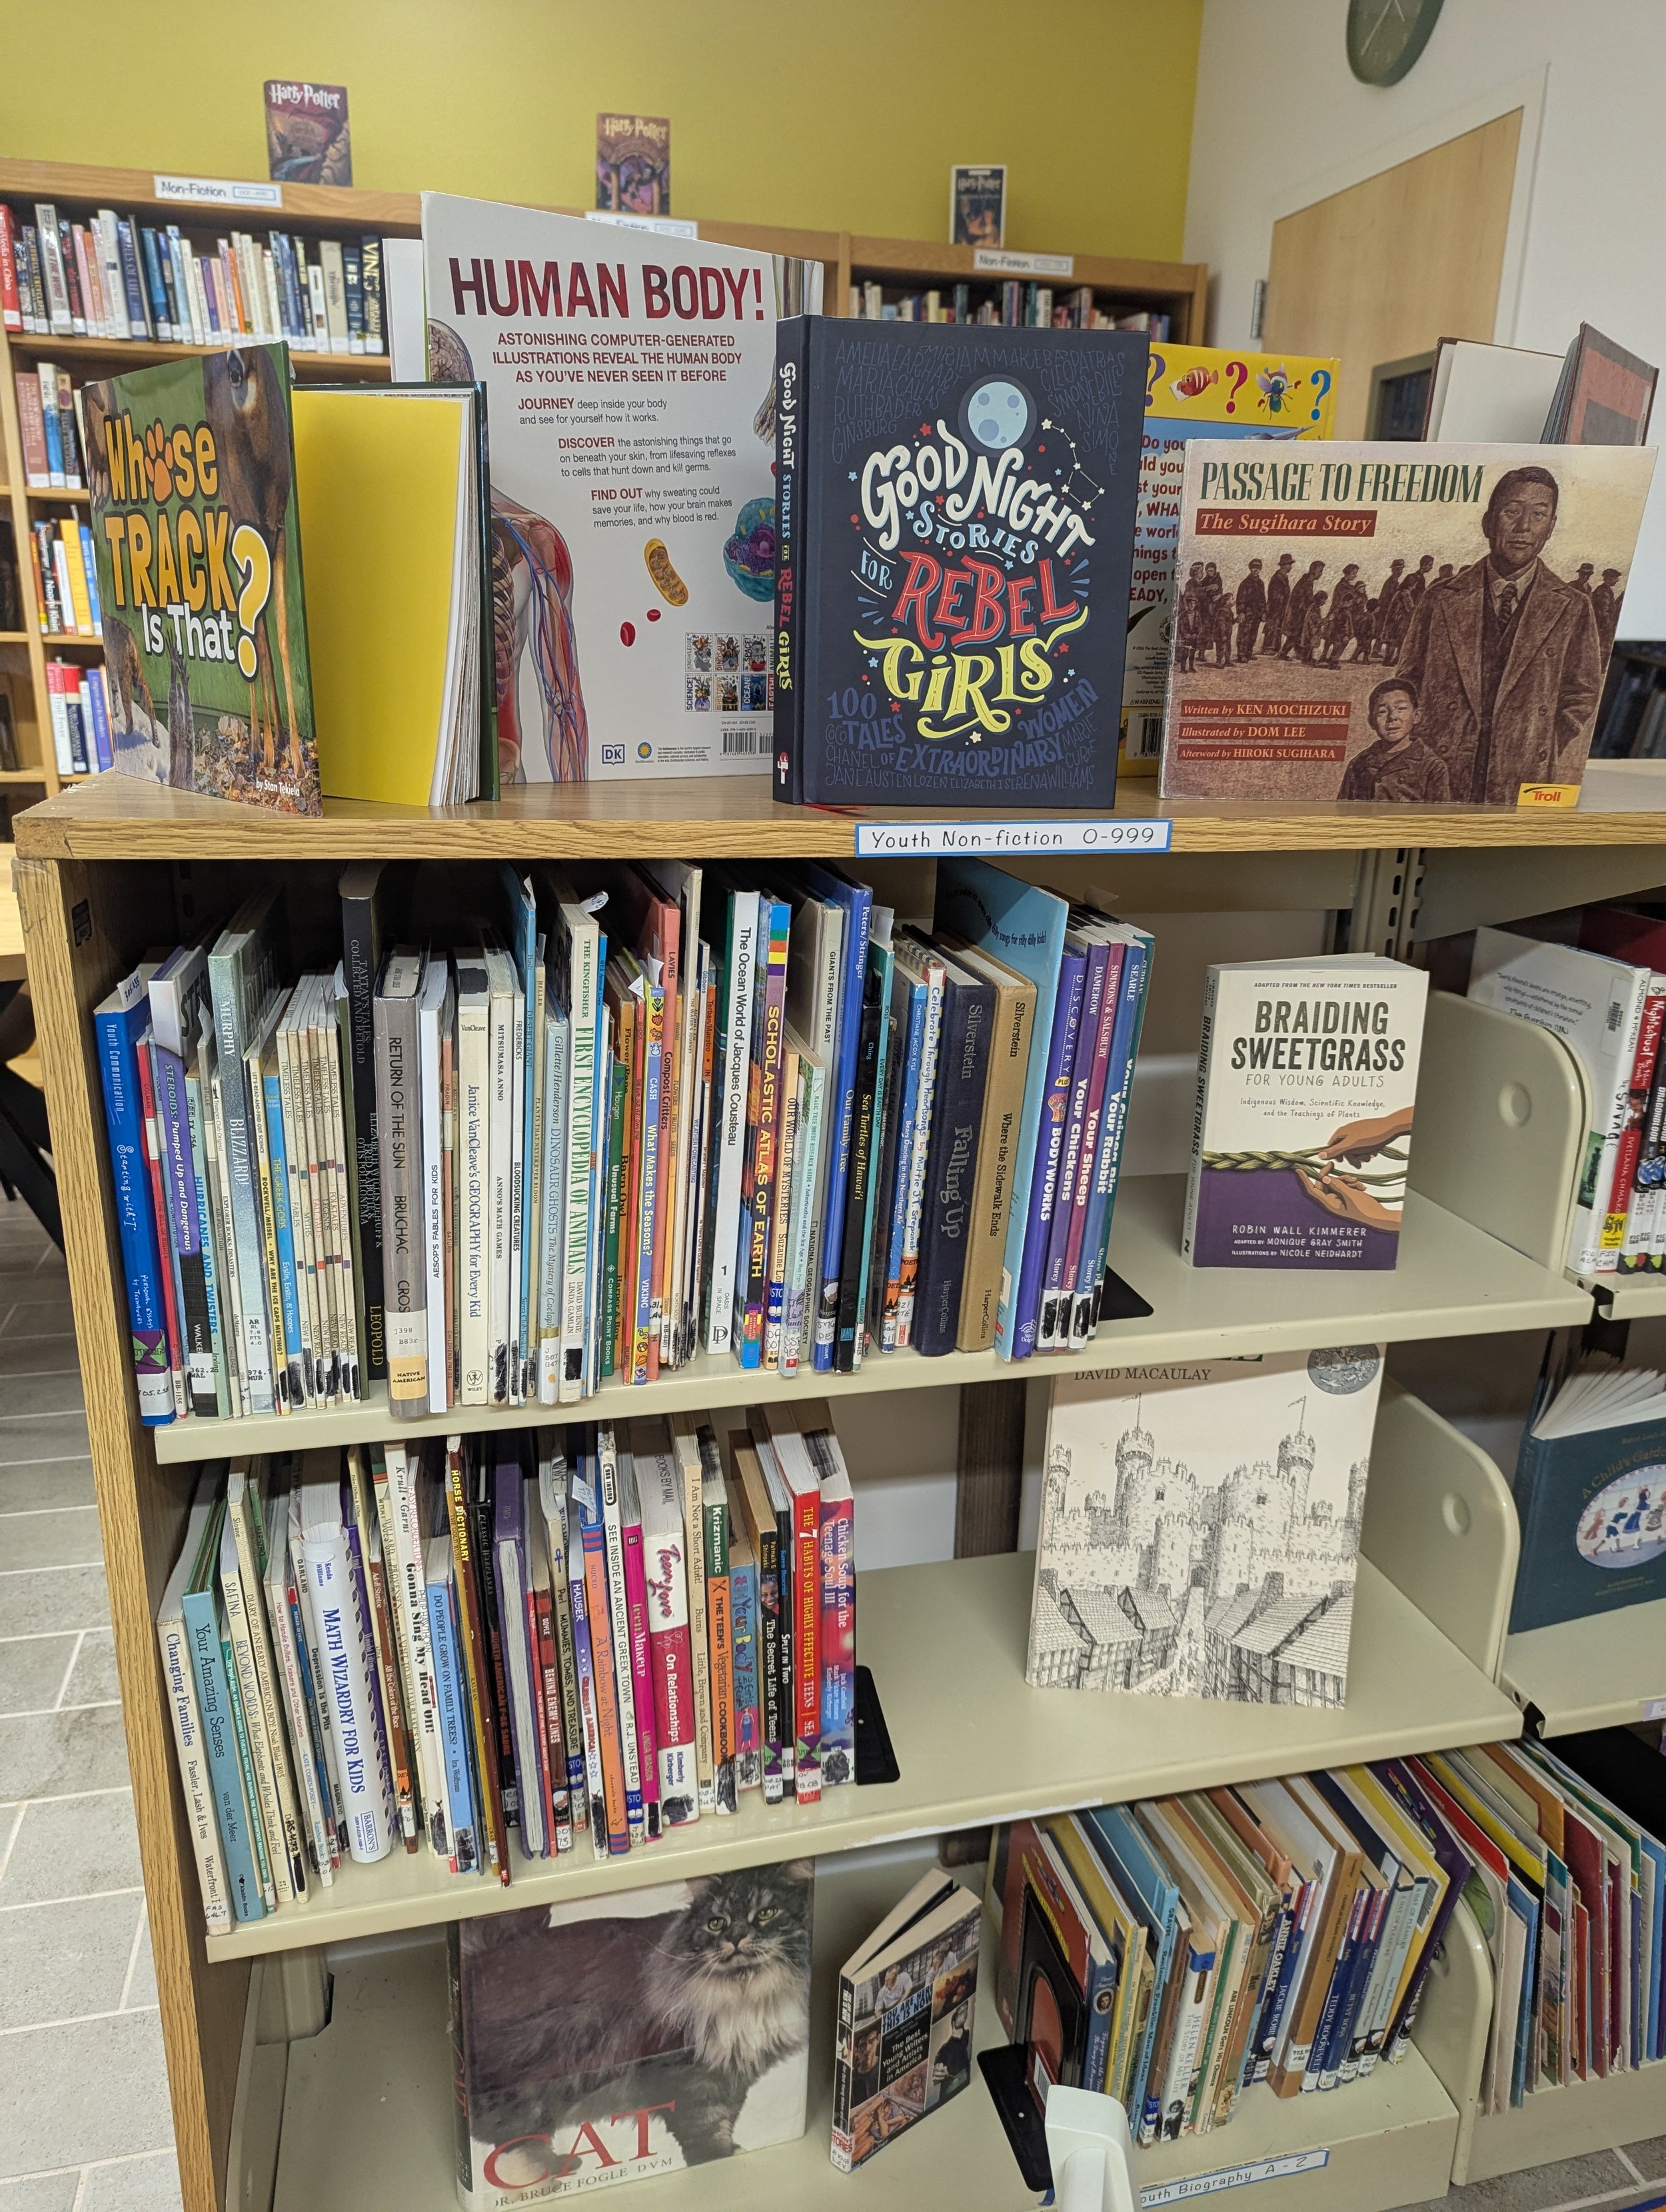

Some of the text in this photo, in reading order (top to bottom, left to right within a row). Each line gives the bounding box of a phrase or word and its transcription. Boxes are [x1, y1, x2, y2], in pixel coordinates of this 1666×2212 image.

[161, 181, 226, 198] Non-Fiction
[449, 257, 764, 320] HUMAN BODY!
[493, 352, 742, 364] ILLUSTRATIONS REVEAL THE HUMAN BODY
[498, 333, 734, 347] ASTONISHING COMPUTER-GENERATED
[516, 370, 726, 382] AS YOU'VE NEVER SEEN IT BEFORE
[518, 398, 667, 412] JOURNEY deep inside your body
[558, 436, 732, 449] DISCOVER the astonishing things that go
[1200, 462, 1486, 504] PASSAGE TO FREEDOM
[913, 500, 1040, 564] STORIES
[1200, 513, 1371, 535] The Sugihara Story
[105, 510, 237, 612] TRACK
[862, 550, 1079, 651] FOR REBEL
[142, 602, 163, 654] Is
[827, 688, 877, 719] 100
[842, 679, 1099, 750] TALES WOMEN
[1183, 702, 1346, 718] Written by KEN MOCHIZUKI
[605, 749, 621, 760] DK
[1179, 748, 1335, 760] Afterword by HIROKI SUGIHARA
[1182, 726, 1306, 740] Illustrated by DOM LEE
[881, 734, 1066, 777] OF EXTRAORDINARY
[256, 778, 300, 797] by Stan Tekiela
[1532, 790, 1561, 803] Troll
[872, 831, 930, 848] Youth
[942, 830, 1063, 846] Non-fiction
[1255, 1001, 1389, 1035] BRAIDING
[1631, 979, 1647, 1014] ALMOND
[219, 999, 236, 1057] MURPHY
[726, 927, 752, 1146] The Ocean World of Jacques Cousteau
[1009, 1001, 1026, 1058] Silverstein
[1641, 1000, 1663, 1057] Nightschool
[107, 1023, 125, 1112] Youth Communication
[1231, 1037, 1405, 1071] SWEETGRASS
[165, 1063, 179, 1119] STEROIDS:
[389, 1037, 405, 1169] RETURN OF THE SUN
[1241, 1098, 1275, 1108] Indigenous
[1309, 1099, 1344, 1107] Scientific
[1246, 1075, 1384, 1088] FOR YOUNG ADULTS
[940, 1004, 982, 1239] Silverstein Falling Up
[1649, 1086, 1666, 1143] DRAGONBLOOD
[752, 1005, 780, 1279] SCHOLASTIC ATLAS OF EARTH
[1040, 1127, 1062, 1222] BODYWORKS
[1232, 1225, 1367, 1236] ROBIN WALL KIMMERER
[369, 1305, 384, 1366] LEOPOLD
[1075, 1368, 1212, 1381] DAVID MACAULAY
[451, 1470, 470, 1562] HORSE DICTIONARY
[712, 1507, 722, 1574] Krizmanic
[166, 1633, 194, 1748] Changing Families
[323, 1609, 365, 1794] MATH WIZARDRY FOR KIDS
[666, 1654, 679, 1742] On Relationships
[1224, 2004, 1236, 2038] LINCOLN
[1180, 2016, 1202, 2090] HELEN KELLER
[484, 2099, 676, 2189] CAT
[520, 2181, 572, 2201] BRUCE
[577, 2167, 628, 2188] FOGLE
[637, 2157, 672, 2173] DVM
[1141, 2189, 1170, 2203] outh
[1178, 2172, 1251, 2195] Biography
[1265, 2165, 1275, 2174] A
